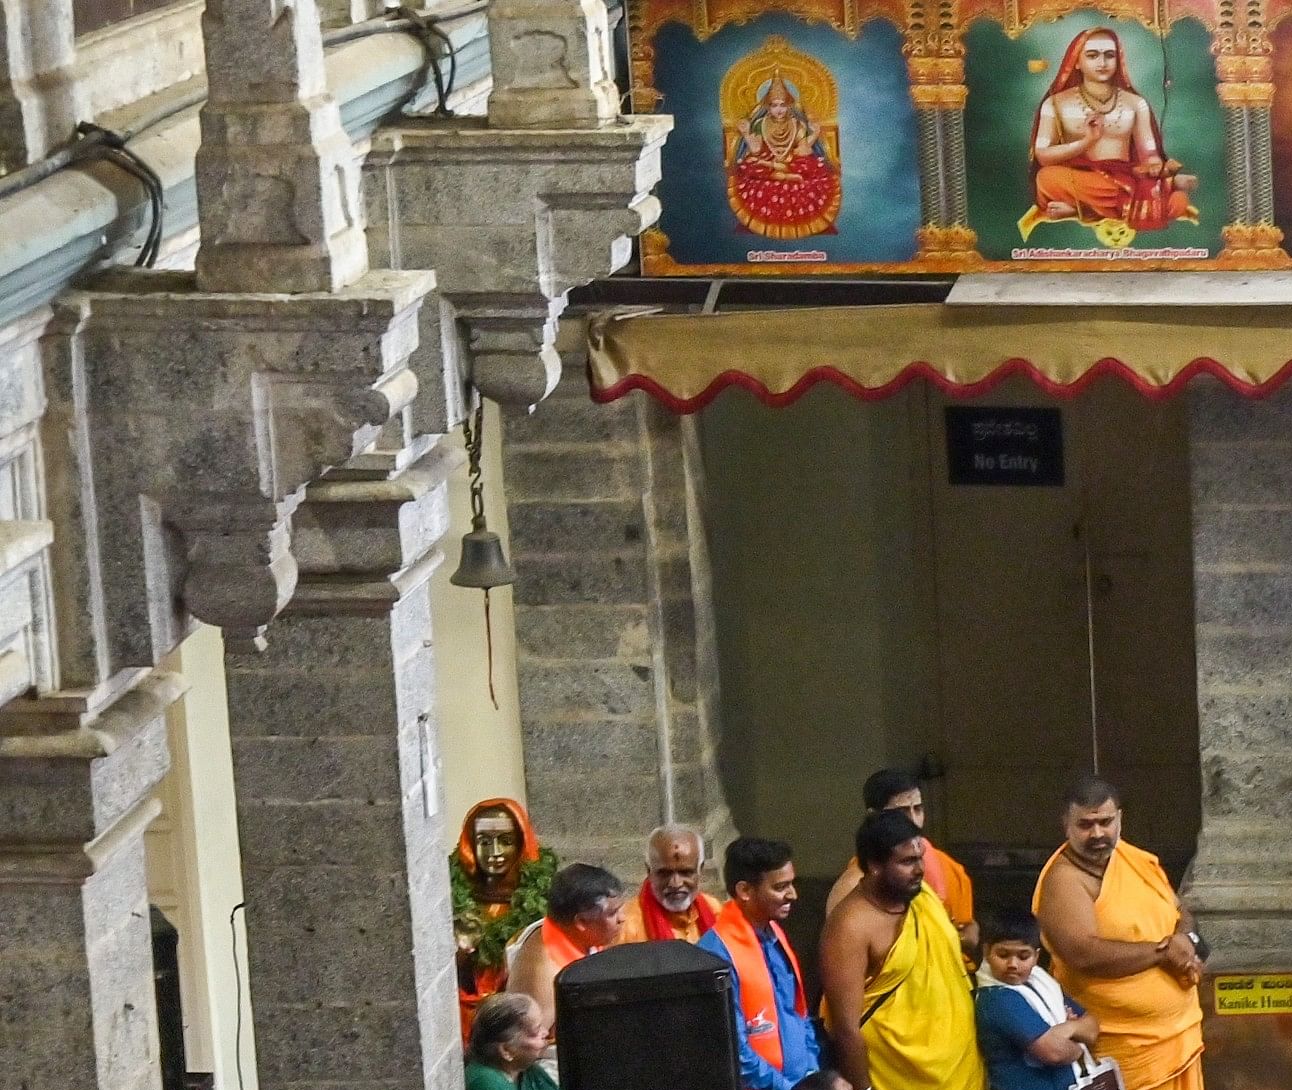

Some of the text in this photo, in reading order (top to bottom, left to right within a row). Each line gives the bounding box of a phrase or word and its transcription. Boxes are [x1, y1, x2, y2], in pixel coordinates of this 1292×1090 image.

[1013, 249, 1026, 259] Sri
[975, 454, 1038, 472] No Entry
[1219, 997, 1258, 1010] Kanike
